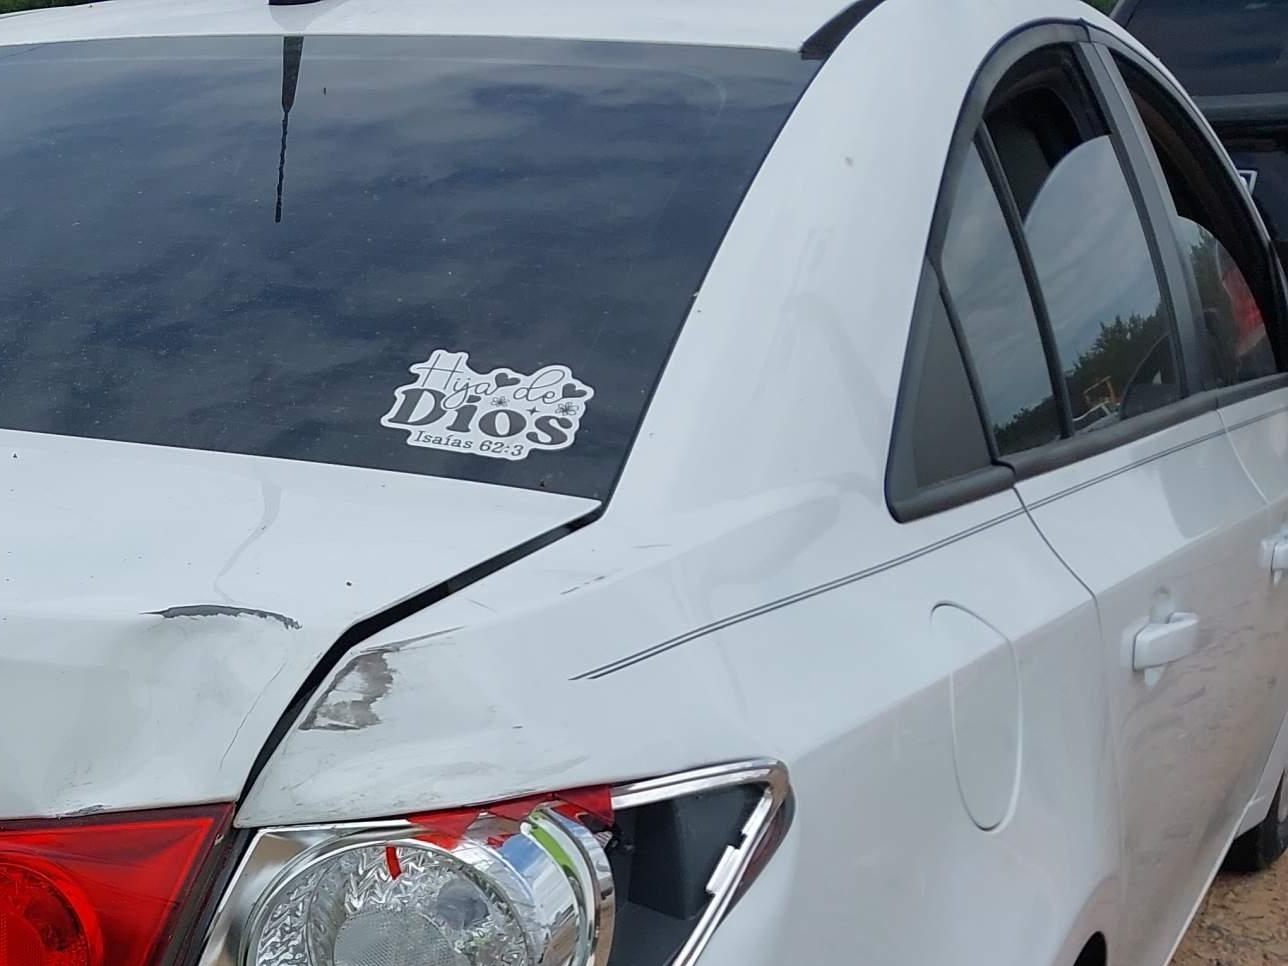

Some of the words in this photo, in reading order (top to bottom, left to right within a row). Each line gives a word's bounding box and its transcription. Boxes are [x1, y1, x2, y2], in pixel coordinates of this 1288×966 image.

[415, 353, 495, 410] Hija
[513, 369, 565, 405] de
[388, 388, 573, 446] Dios
[479, 439, 525, 457] 62:3
